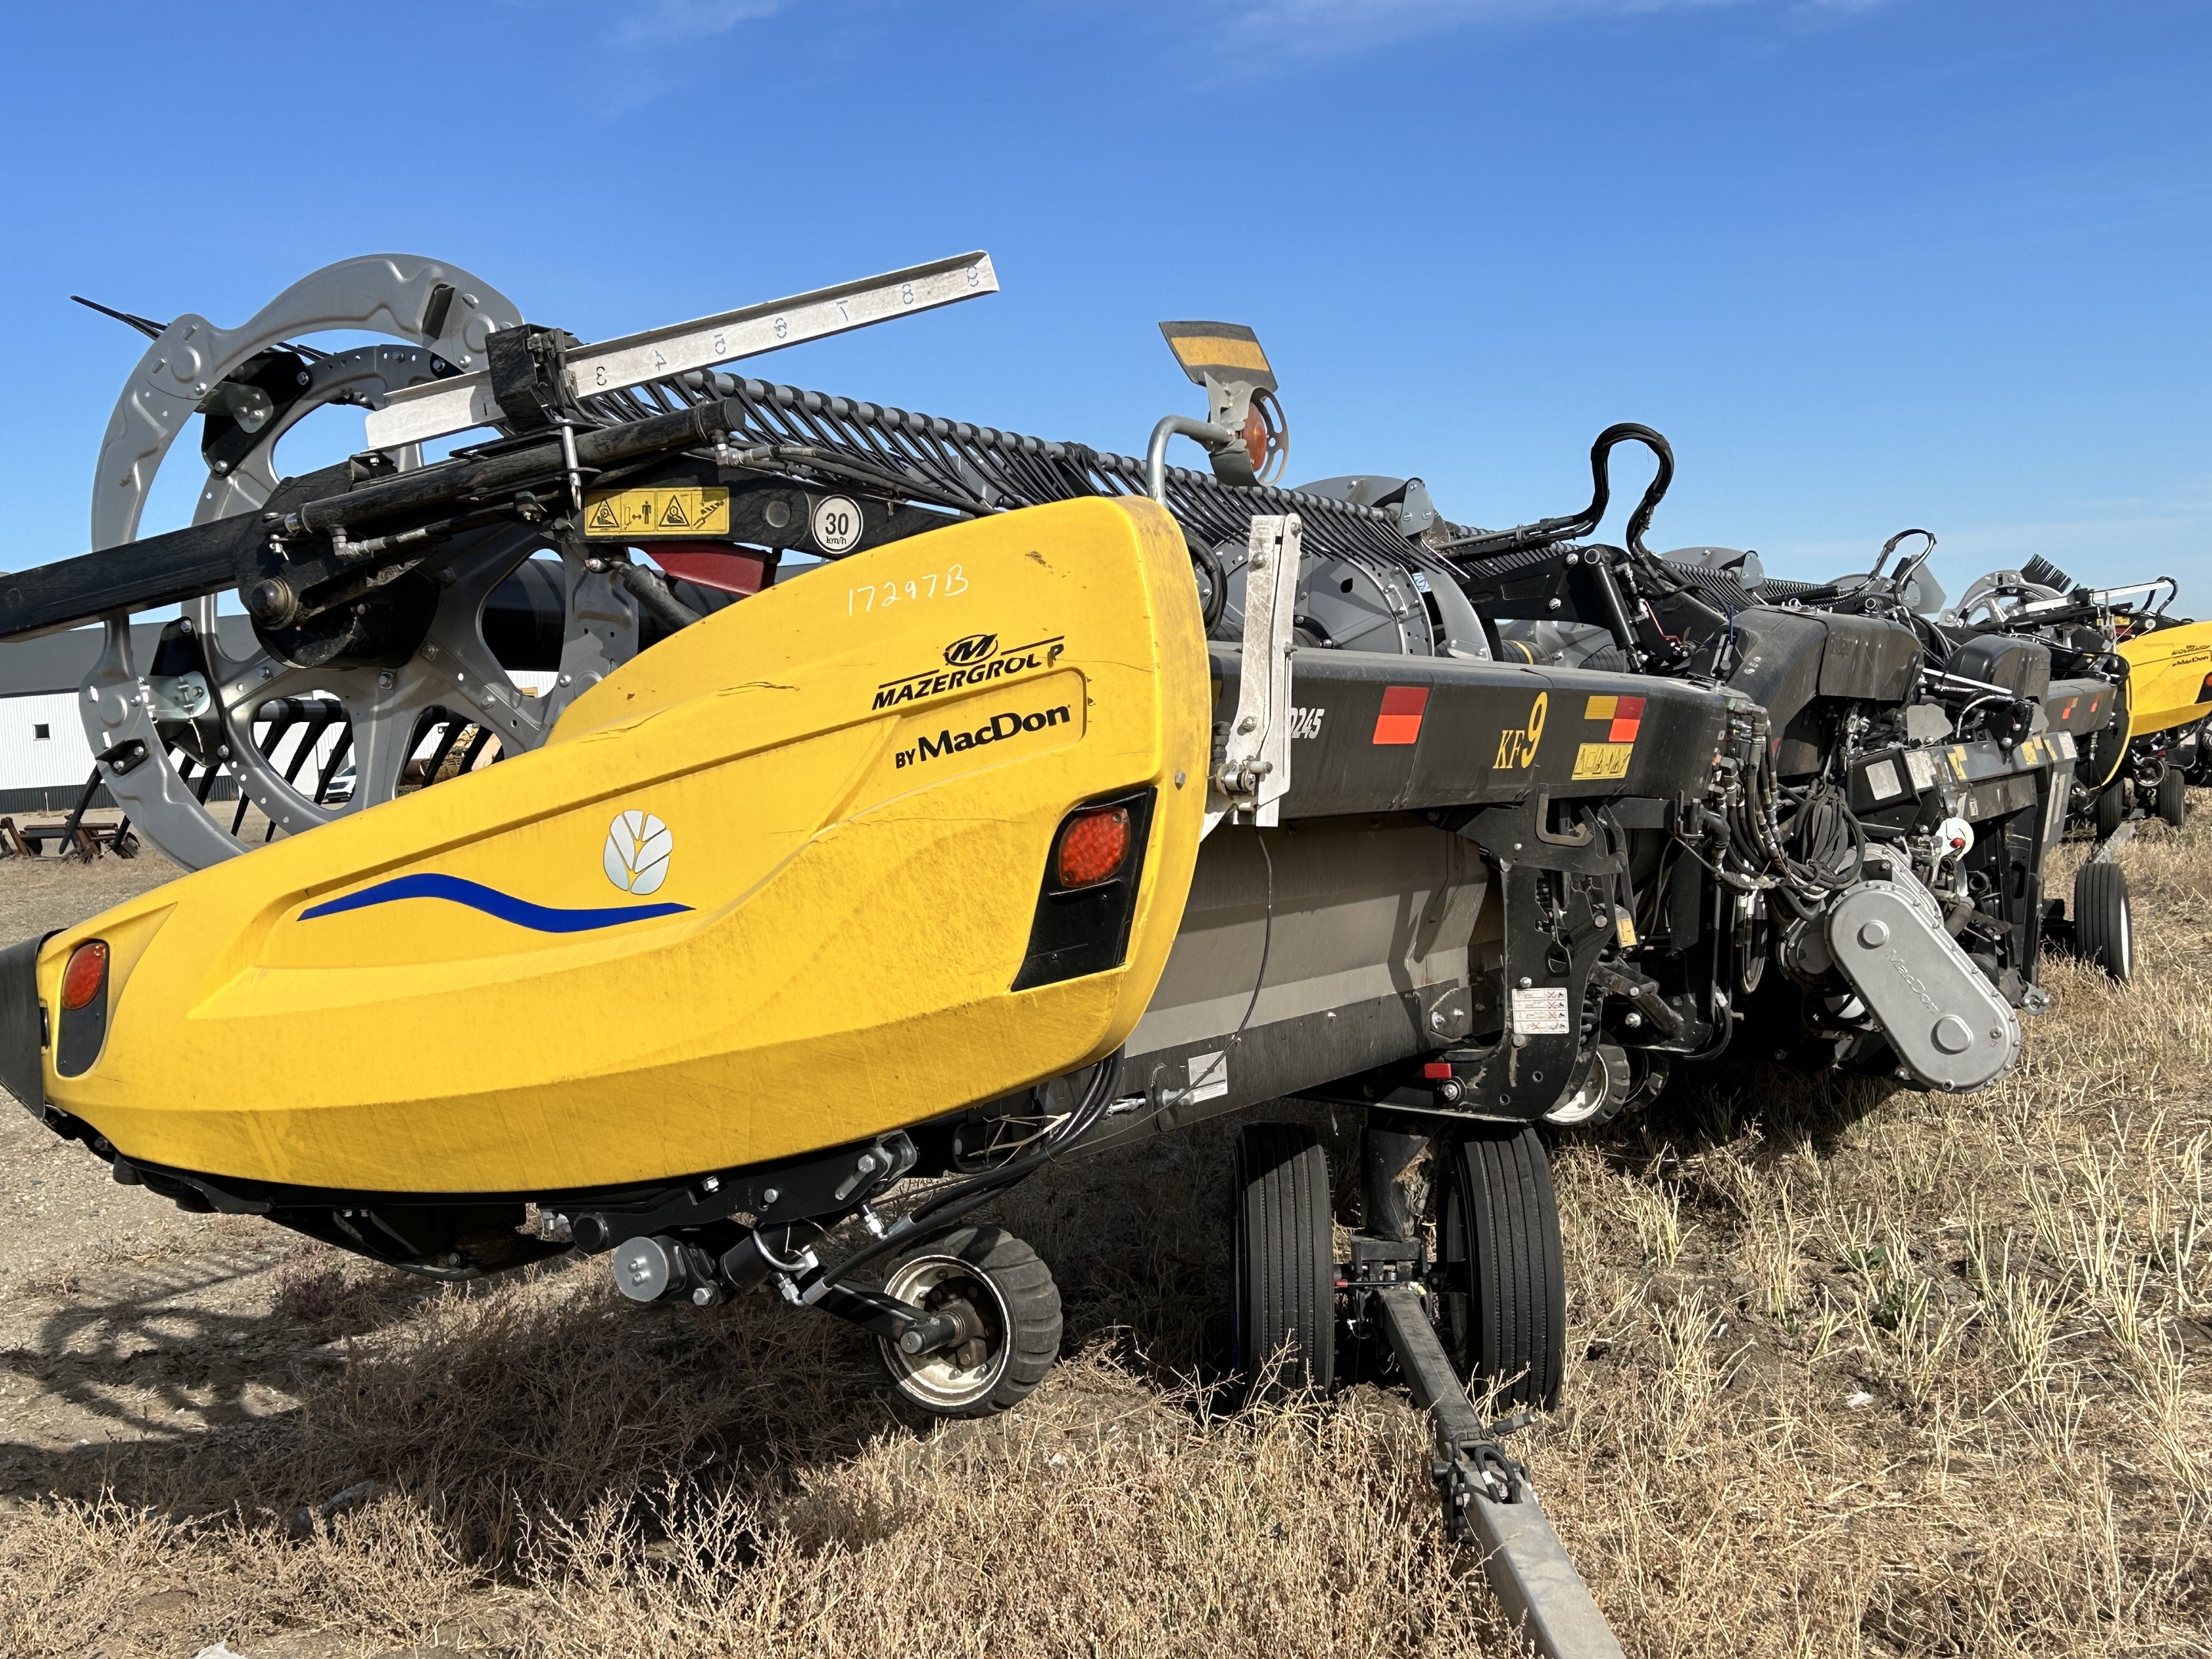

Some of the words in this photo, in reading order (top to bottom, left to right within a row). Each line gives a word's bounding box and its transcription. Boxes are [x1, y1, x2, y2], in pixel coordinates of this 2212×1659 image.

[825, 512, 849, 535] 30
[826, 535, 847, 545] km/h
[848, 564, 969, 617] 17297B
[895, 748, 917, 770] BY
[917, 704, 1071, 762] MacDon
[1492, 691, 1548, 769] KF9
